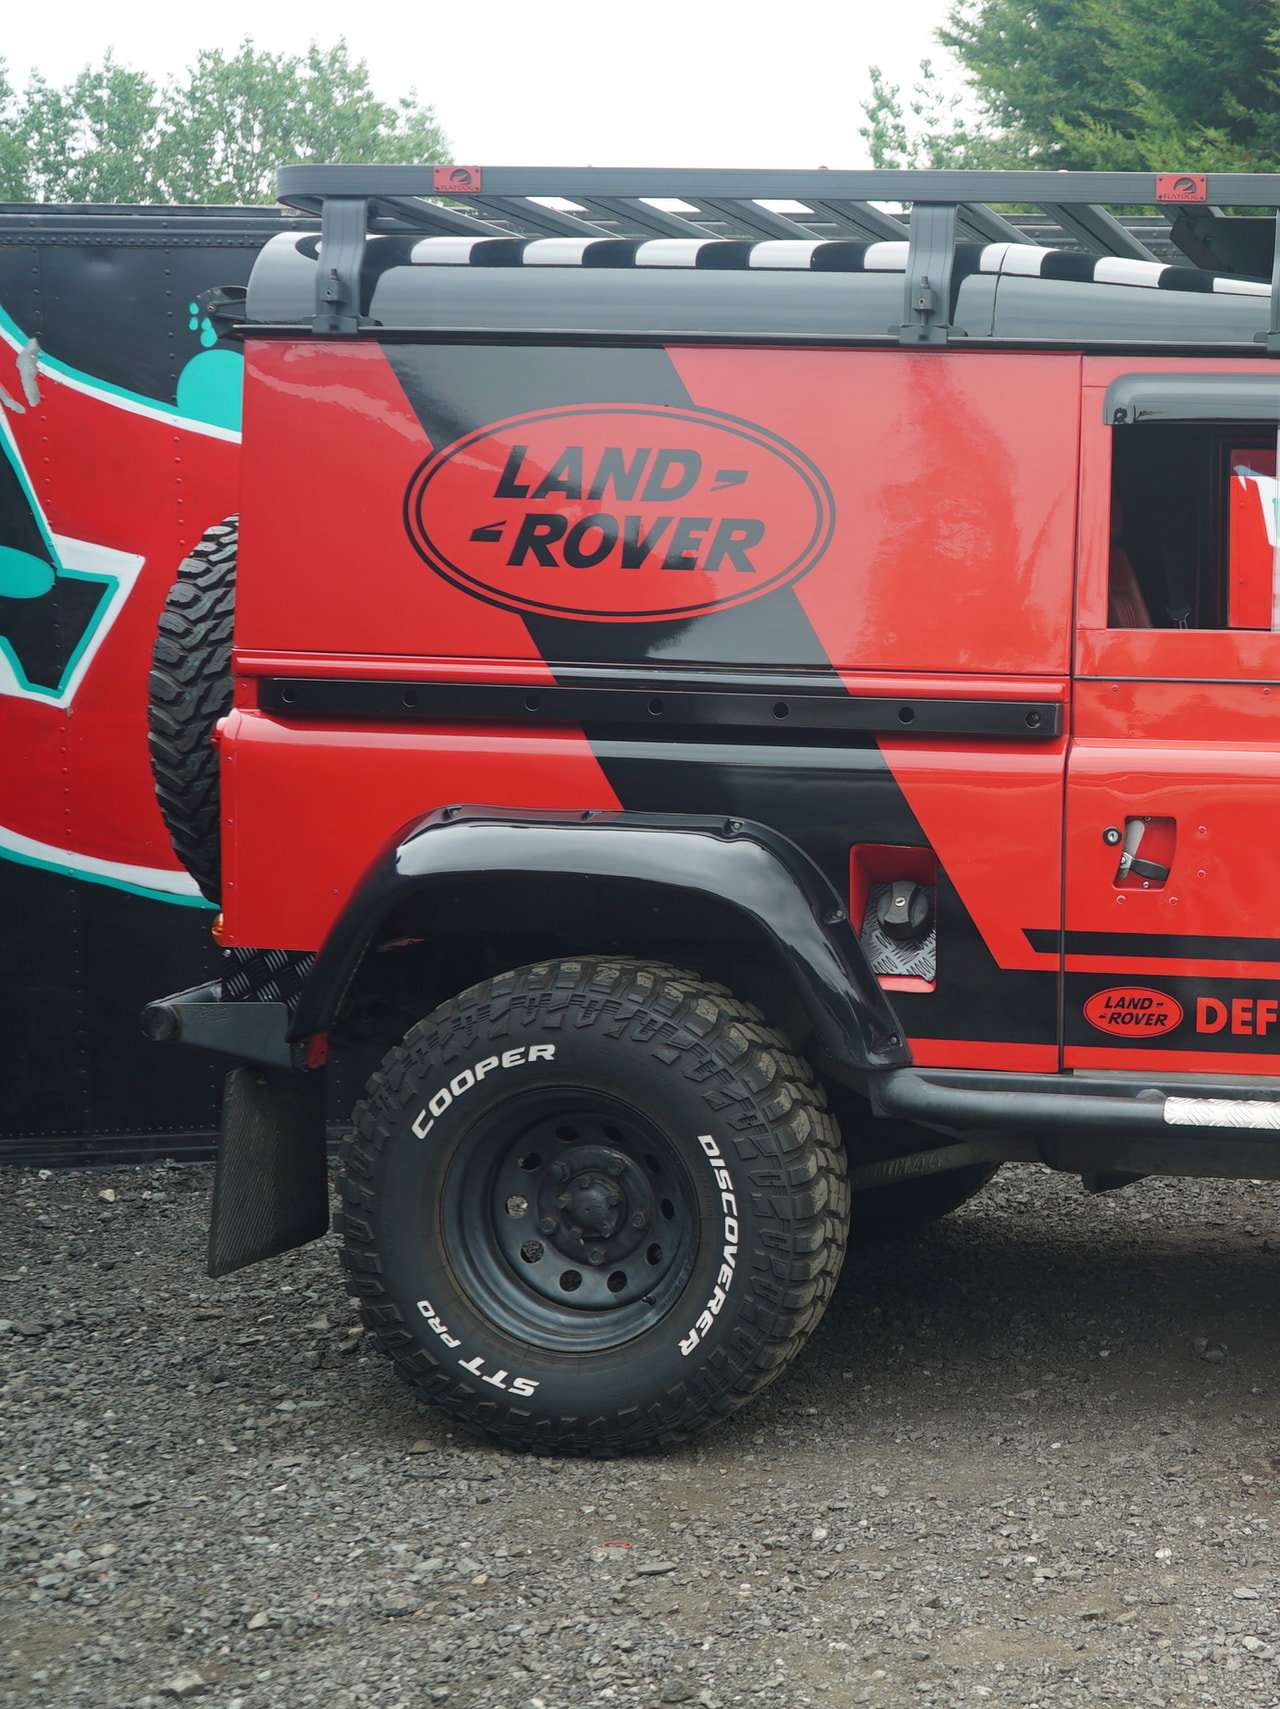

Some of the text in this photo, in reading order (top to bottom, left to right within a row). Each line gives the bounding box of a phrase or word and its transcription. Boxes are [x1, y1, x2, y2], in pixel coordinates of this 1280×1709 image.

[493, 444, 703, 502] LAND
[506, 513, 767, 573] ROVER
[1103, 997, 1154, 1010] LAND
[1108, 1012, 1168, 1027] ROVER
[411, 1044, 556, 1140] COOPER
[677, 1134, 739, 1356] DISCOVERER
[416, 1300, 540, 1397] STT PRO
